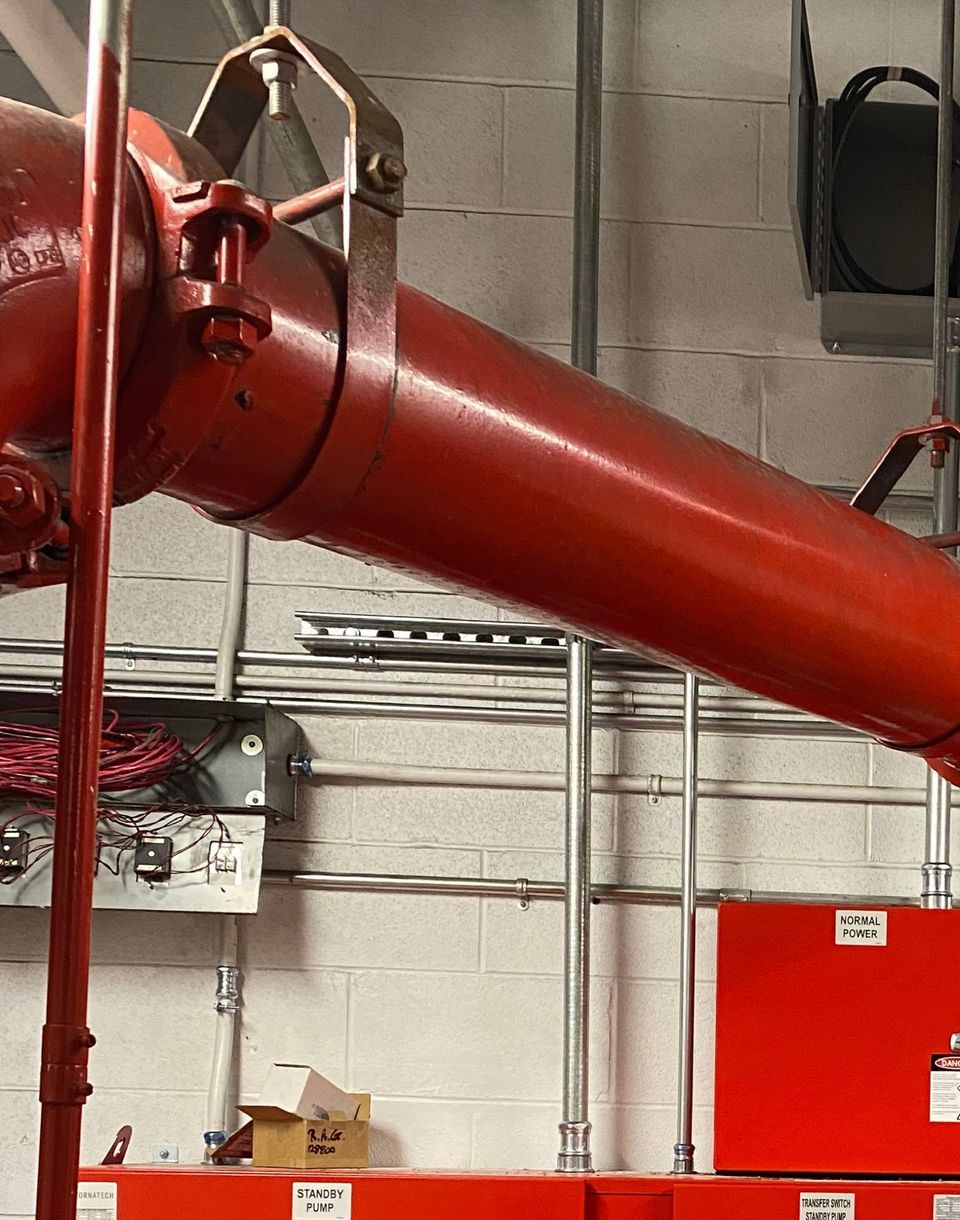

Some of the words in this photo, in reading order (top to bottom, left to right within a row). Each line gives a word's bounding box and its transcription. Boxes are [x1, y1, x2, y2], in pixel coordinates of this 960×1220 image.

[841, 916, 881, 926] NORMAL
[843, 929, 878, 938] POWER
[297, 1189, 344, 1199] STANDBY
[306, 1203, 334, 1212] PUMP
[802, 1199, 830, 1208] TRANSFER
[830, 1199, 851, 1208] SWITCH
